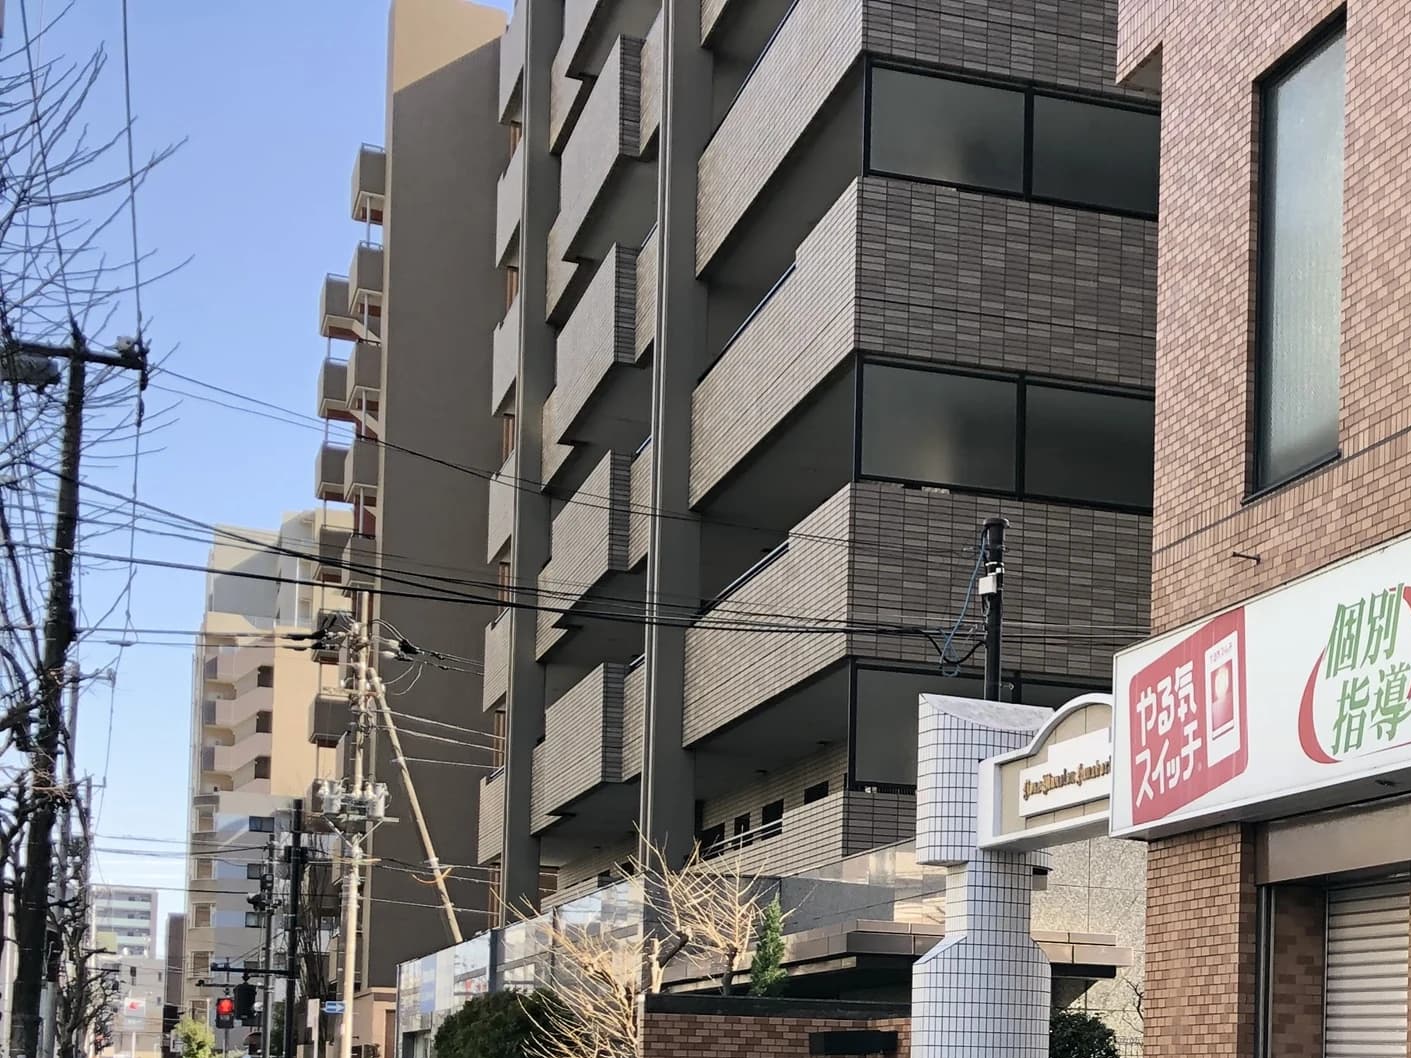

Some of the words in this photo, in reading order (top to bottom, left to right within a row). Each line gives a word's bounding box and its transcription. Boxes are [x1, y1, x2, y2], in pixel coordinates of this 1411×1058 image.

[1325, 582, 1404, 680] 個別
[1136, 660, 1197, 746] やる気
[1135, 720, 1202, 808] スイッチ
